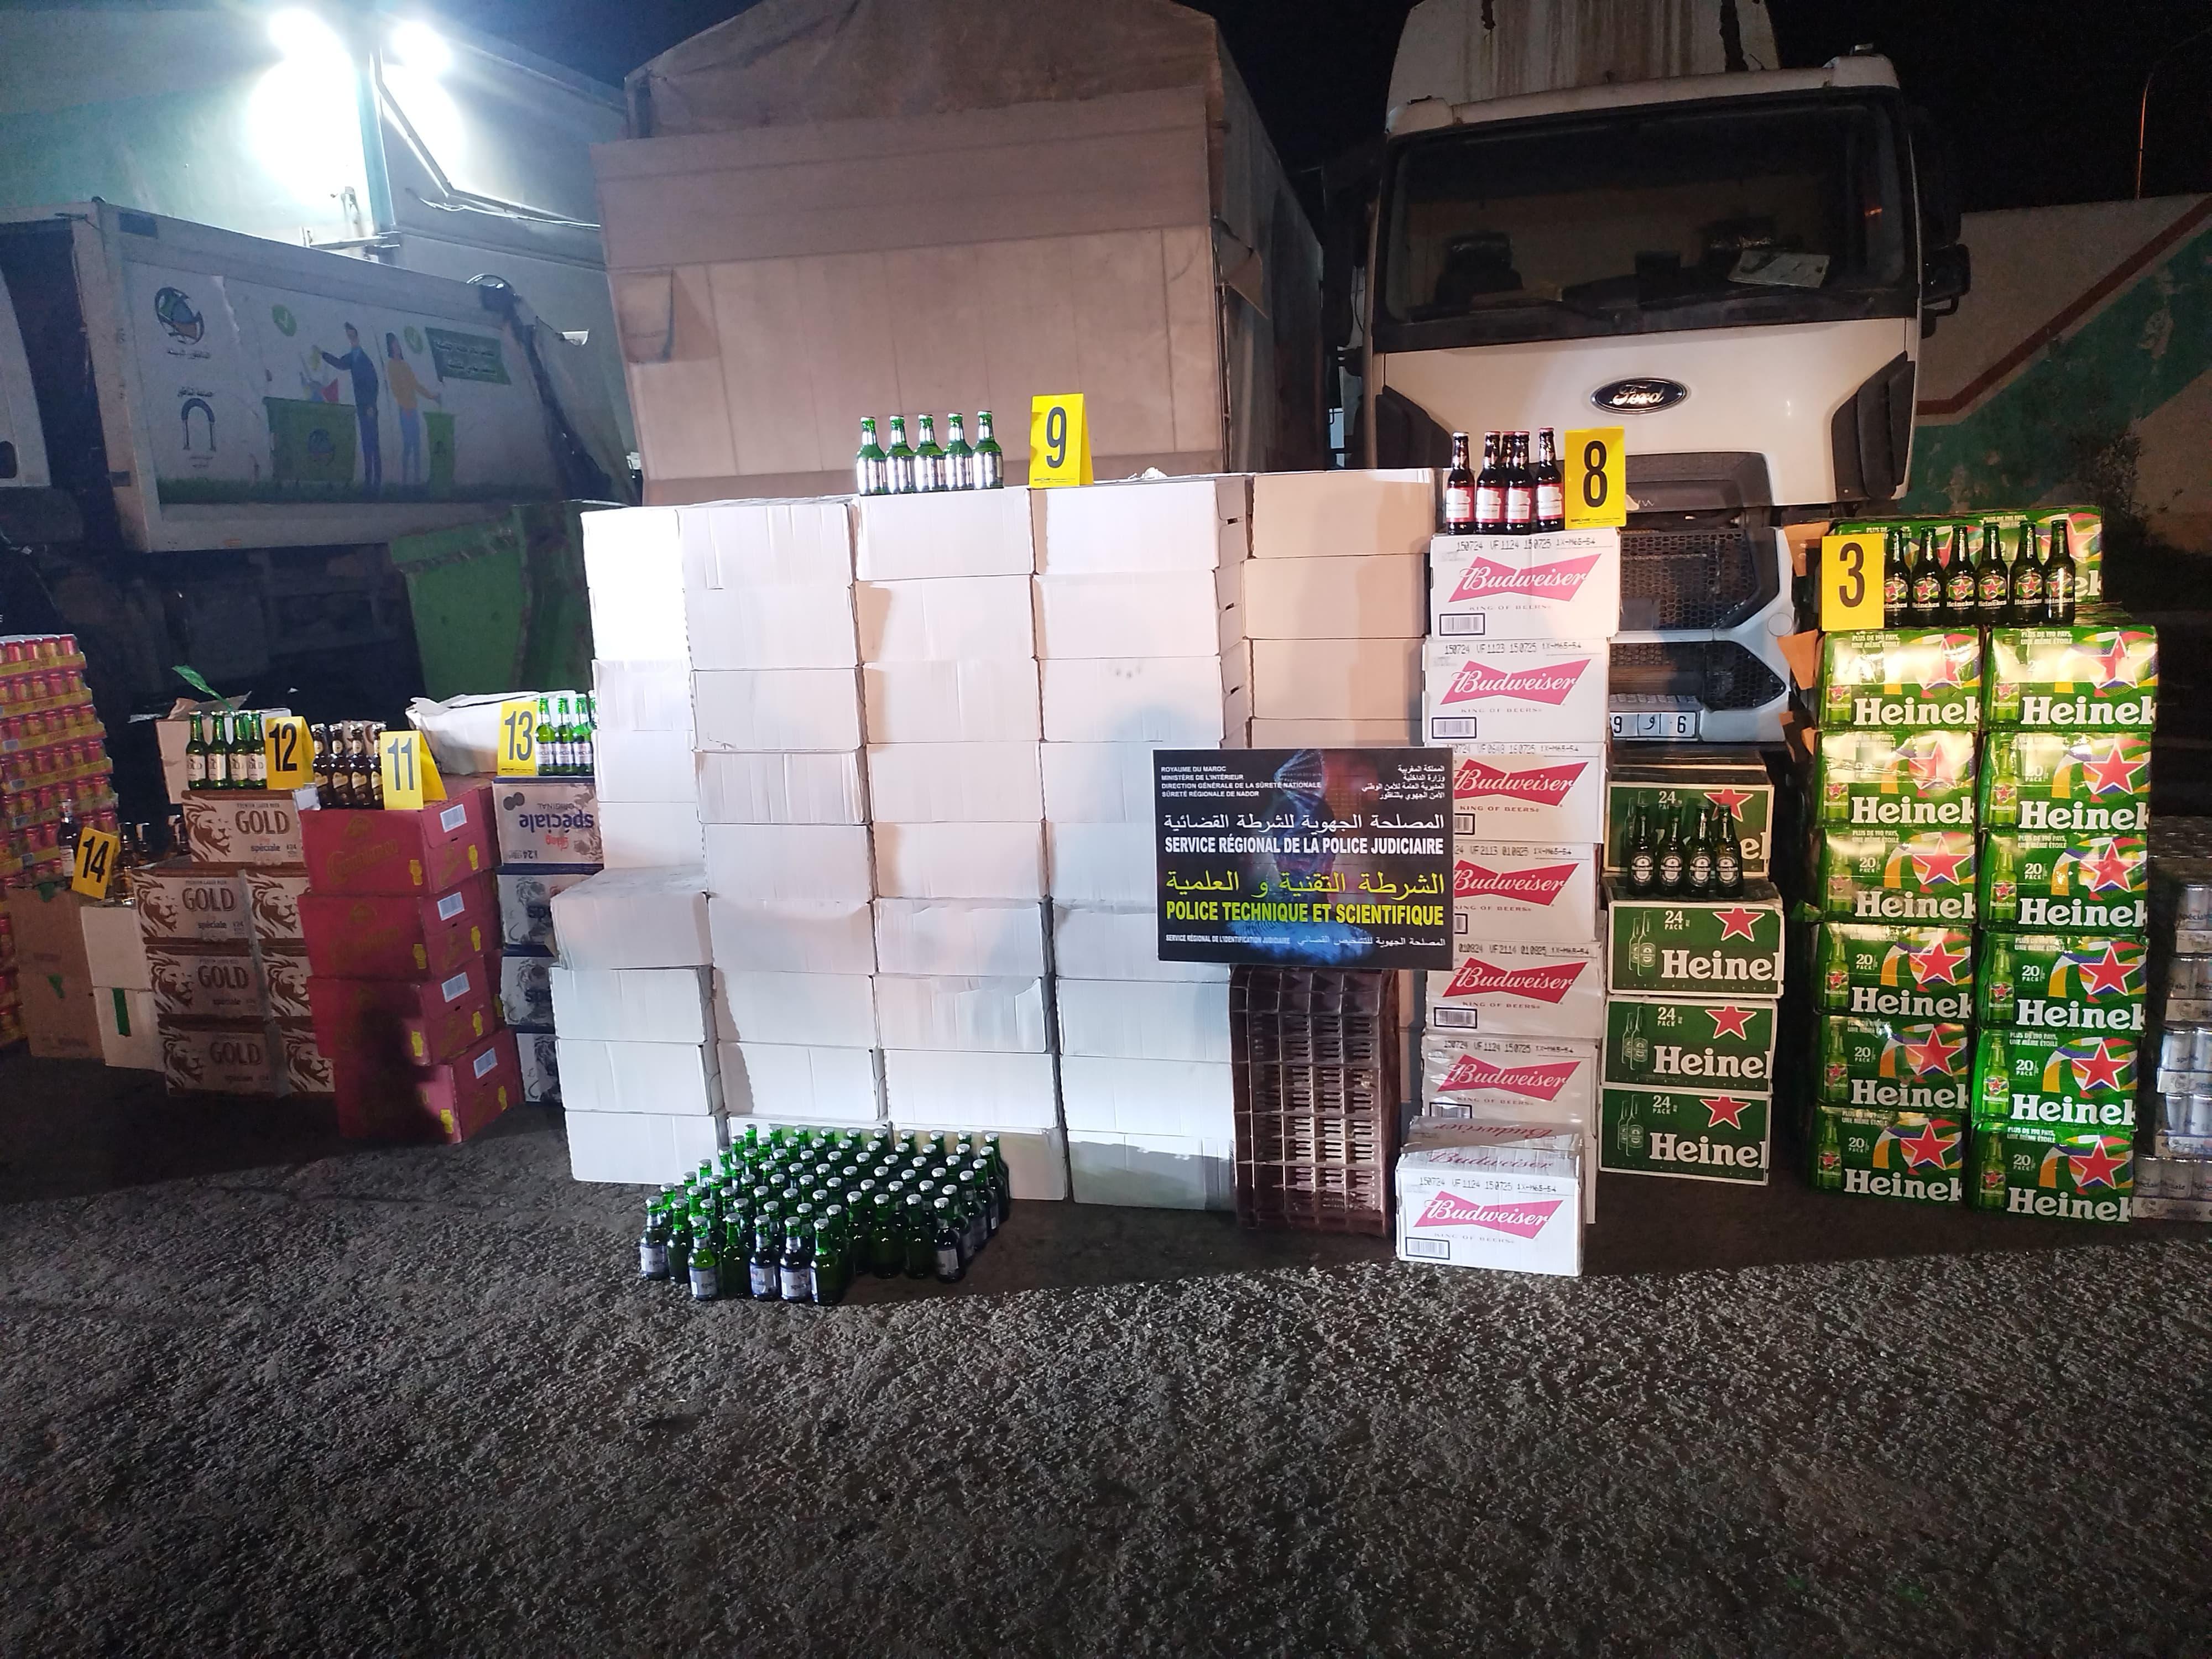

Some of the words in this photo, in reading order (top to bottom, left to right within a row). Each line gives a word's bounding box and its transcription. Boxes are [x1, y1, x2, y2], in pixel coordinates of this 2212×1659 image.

[1613, 384, 1665, 405] Ford
[1046, 407, 1066, 468] 9
[1583, 441, 1607, 508] 8
[1459, 566, 1588, 590] Budweiser
[1838, 542, 1865, 607] 3
[1452, 670, 1577, 692] Budweiser
[1610, 716, 1622, 733] 9
[1643, 715, 1655, 729] و
[1677, 716, 1686, 733] 6
[504, 711, 533, 760] 13
[269, 723, 297, 771] 12
[388, 737, 414, 790] 11
[1398, 765, 1422, 774] المغربية
[1454, 769, 1574, 792] Budweiser
[1659, 791, 1676, 804] 24
[235, 810, 290, 835] GOLD
[519, 810, 594, 833] spéciale
[1163, 813, 1229, 831] القضائية
[1236, 813, 1295, 833] للشرطة
[1301, 814, 1362, 835] الجهوية
[1370, 814, 1444, 829] المصلحة
[1165, 837, 1215, 853] SERVICE
[1219, 833, 1280, 853] RÉGIONAL
[1284, 837, 1300, 853] DE
[1303, 837, 1319, 853] LA
[1323, 837, 1368, 854] POLICE
[1371, 838, 1444, 854] JUDICIAIRE
[83, 836, 109, 883] 14
[1859, 857, 1876, 868] 20
[2025, 863, 2042, 874] 20
[1166, 870, 1239, 895] العلمية
[1251, 881, 1269, 898] و
[1279, 872, 1346, 897] التقنية
[1359, 872, 1444, 900] الشرطة
[1454, 869, 1567, 891] Budweiser
[182, 888, 237, 911] GOLD
[1167, 901, 1218, 920] POLICE
[1222, 902, 1308, 922] TECHNIQUE
[1313, 904, 1332, 922] ET
[1336, 904, 1444, 927] SCIENTIFIQUE
[1665, 911, 1683, 923] 24
[1187, 933, 1211, 942] RÉGIONAL
[1376, 937, 1406, 947] الجهوية
[1410, 938, 1446, 947] المصلحة
[1856, 954, 1873, 966] 20
[197, 965, 248, 989] GOLD
[1453, 966, 1574, 989] Budweiser
[2022, 965, 2039, 977] 20
[1658, 1007, 1676, 1020] 24
[210, 1042, 262, 1066] GOLD
[1854, 1046, 1871, 1057] 20
[1448, 1062, 1568, 1087] Budweiser
[2016, 1059, 2033, 1071] 20
[1652, 1095, 1671, 1108] 24
[1848, 1137, 1865, 1148] 20
[1428, 1151, 1553, 1169] Budweiser
[2013, 1154, 2031, 1166] 20
[1424, 1198, 1552, 1227] Budweiser
